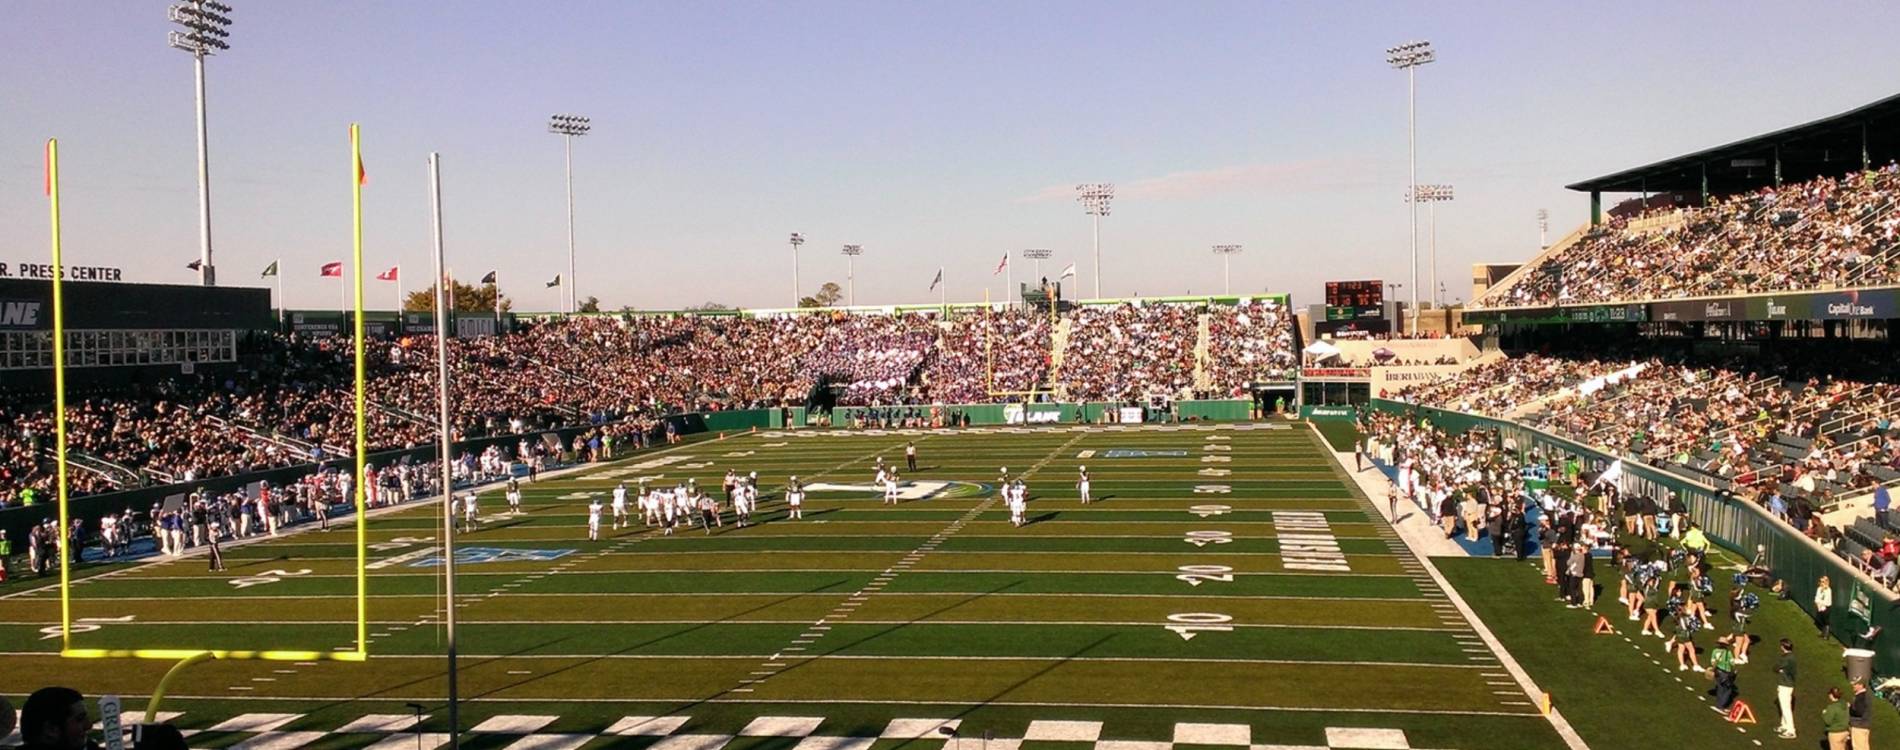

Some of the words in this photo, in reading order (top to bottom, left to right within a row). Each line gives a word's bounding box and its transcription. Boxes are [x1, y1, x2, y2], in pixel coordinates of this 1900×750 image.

[71, 267, 121, 280] CENTER
[1176, 565, 1234, 582] 20
[1164, 612, 1234, 631] 10
